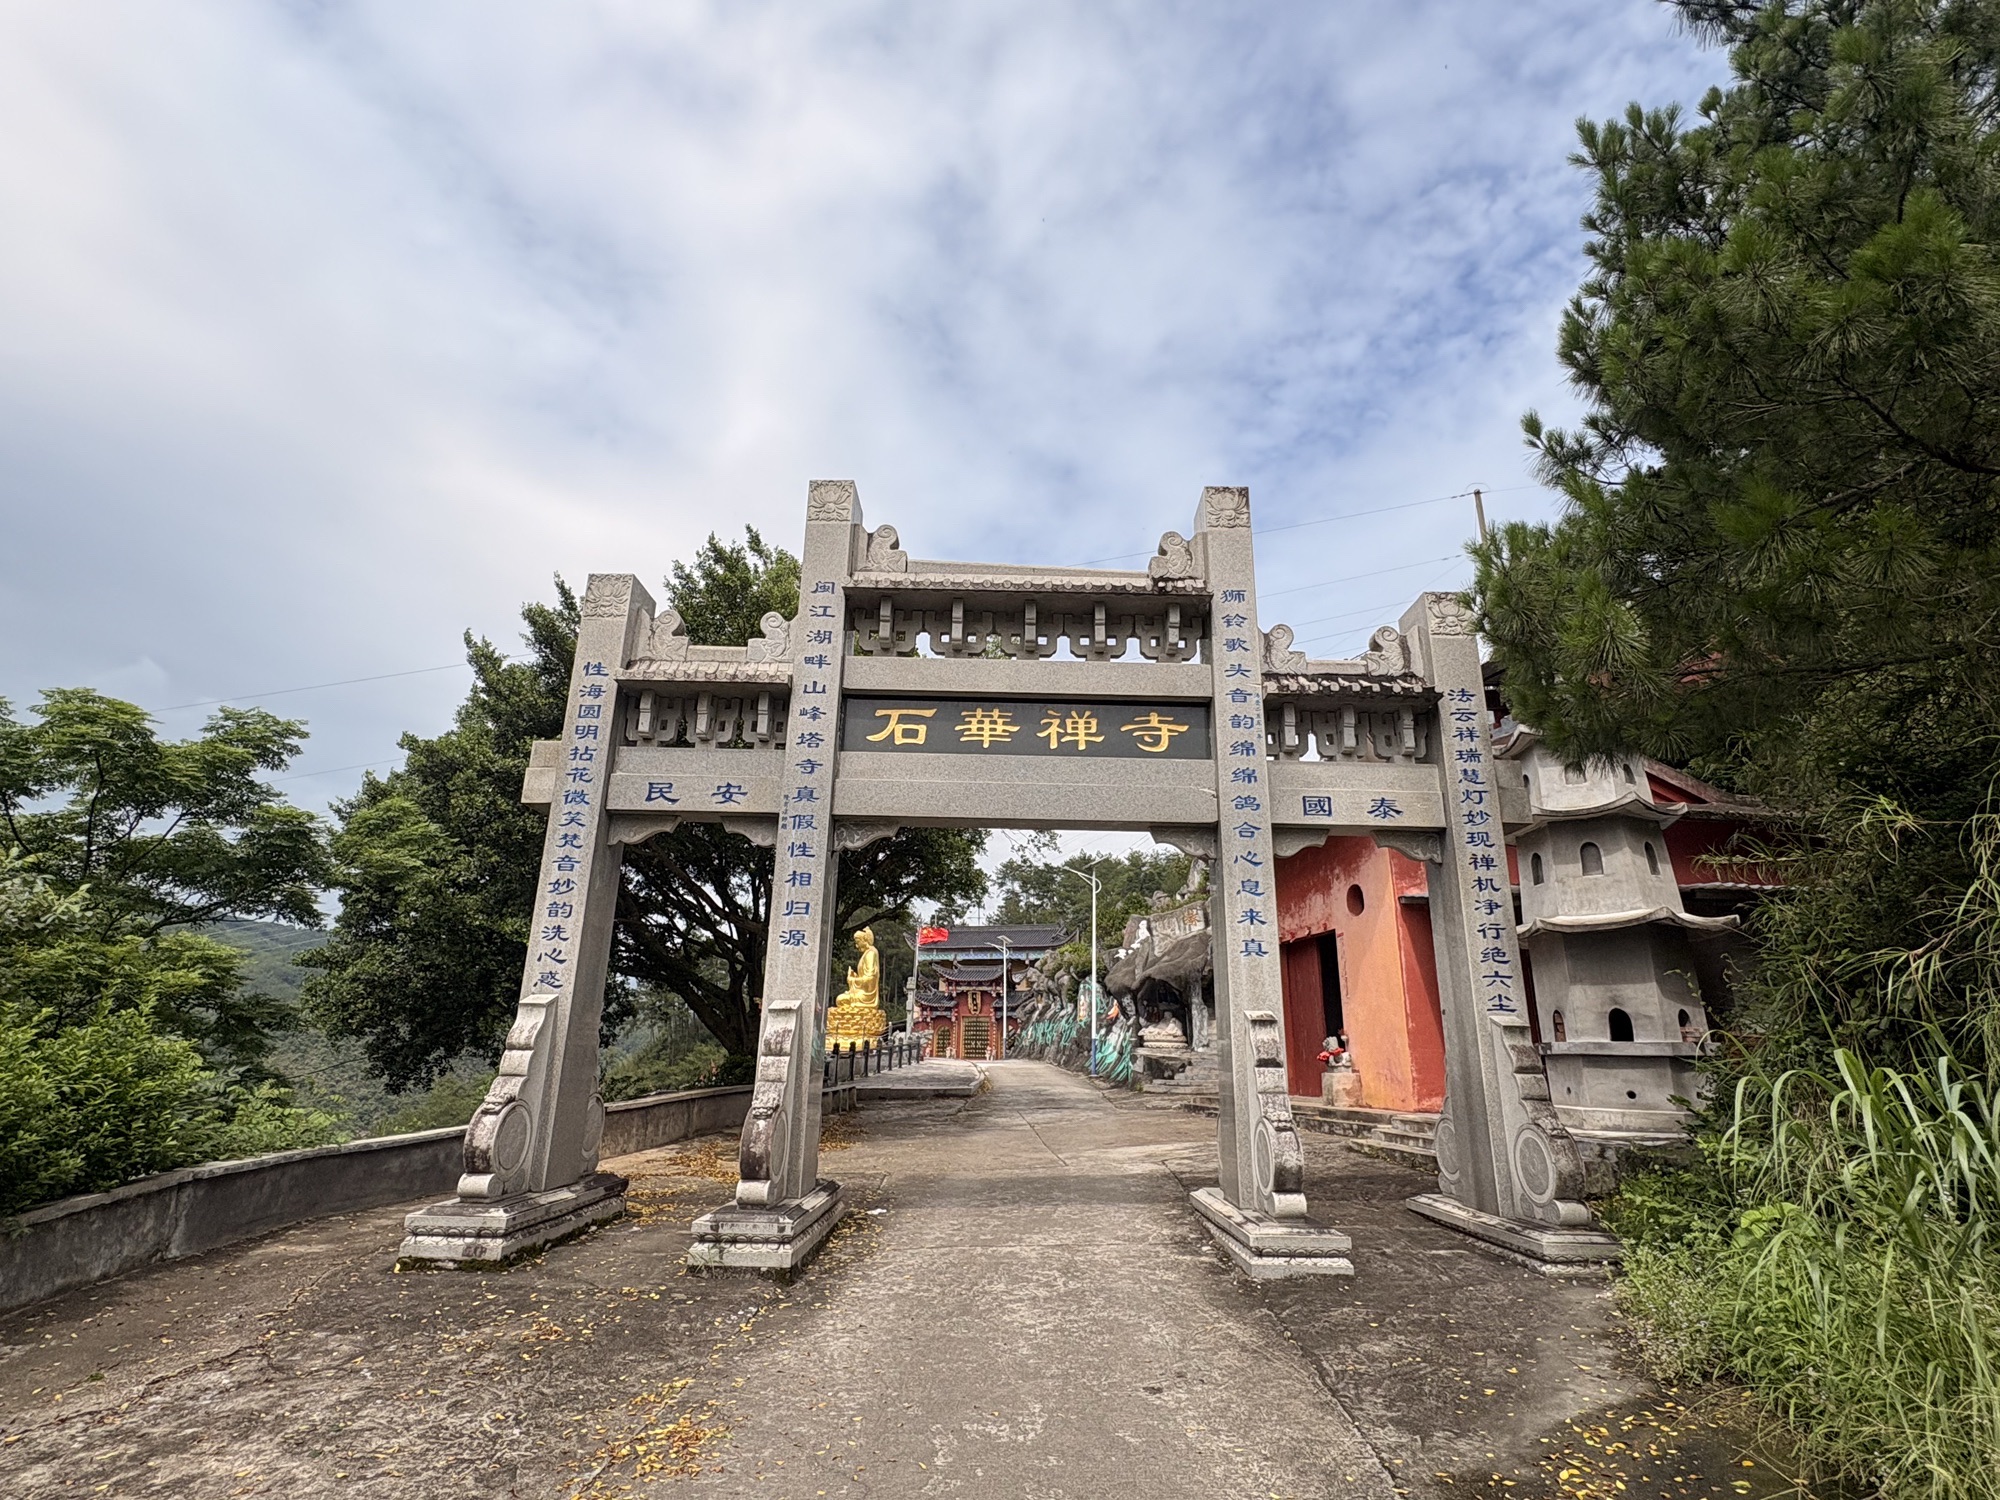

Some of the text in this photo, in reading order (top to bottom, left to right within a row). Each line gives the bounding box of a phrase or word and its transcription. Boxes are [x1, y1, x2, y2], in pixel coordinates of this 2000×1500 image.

[644, 781, 749, 805] 民安
[779, 581, 836, 947] 闽江湖畔山峰塔寺真假性相归源
[866, 707, 1190, 752] 石華禅寺
[1302, 795, 1403, 819] 國泰
[533, 661, 609, 989] 性海圆明拈花微笑梵音妙韵洗心惑
[1447, 688, 1518, 1013] 法云祥瑞慧灯妙现禅机净行绝六尘
